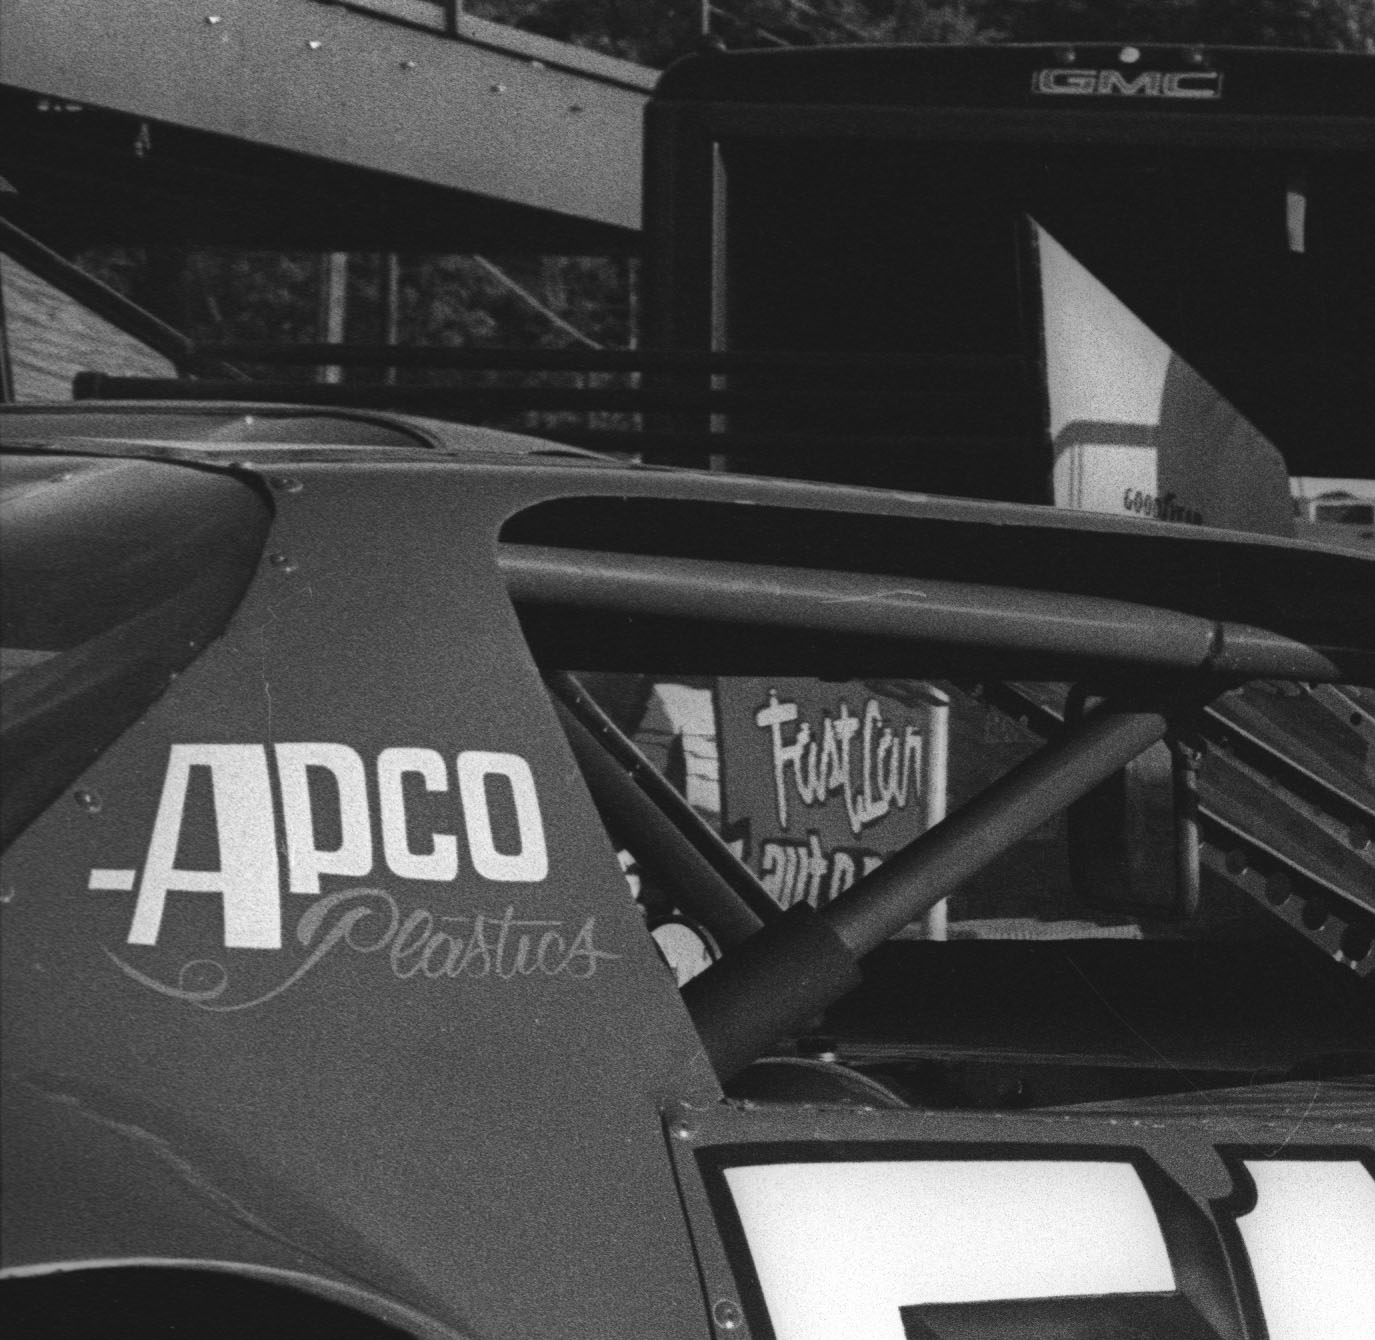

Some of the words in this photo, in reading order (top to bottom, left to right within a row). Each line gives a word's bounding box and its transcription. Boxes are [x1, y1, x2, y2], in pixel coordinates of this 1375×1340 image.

[1038, 68, 1219, 99] GMC
[88, 742, 550, 950] APCO
[180, 888, 622, 1008] Plastics
